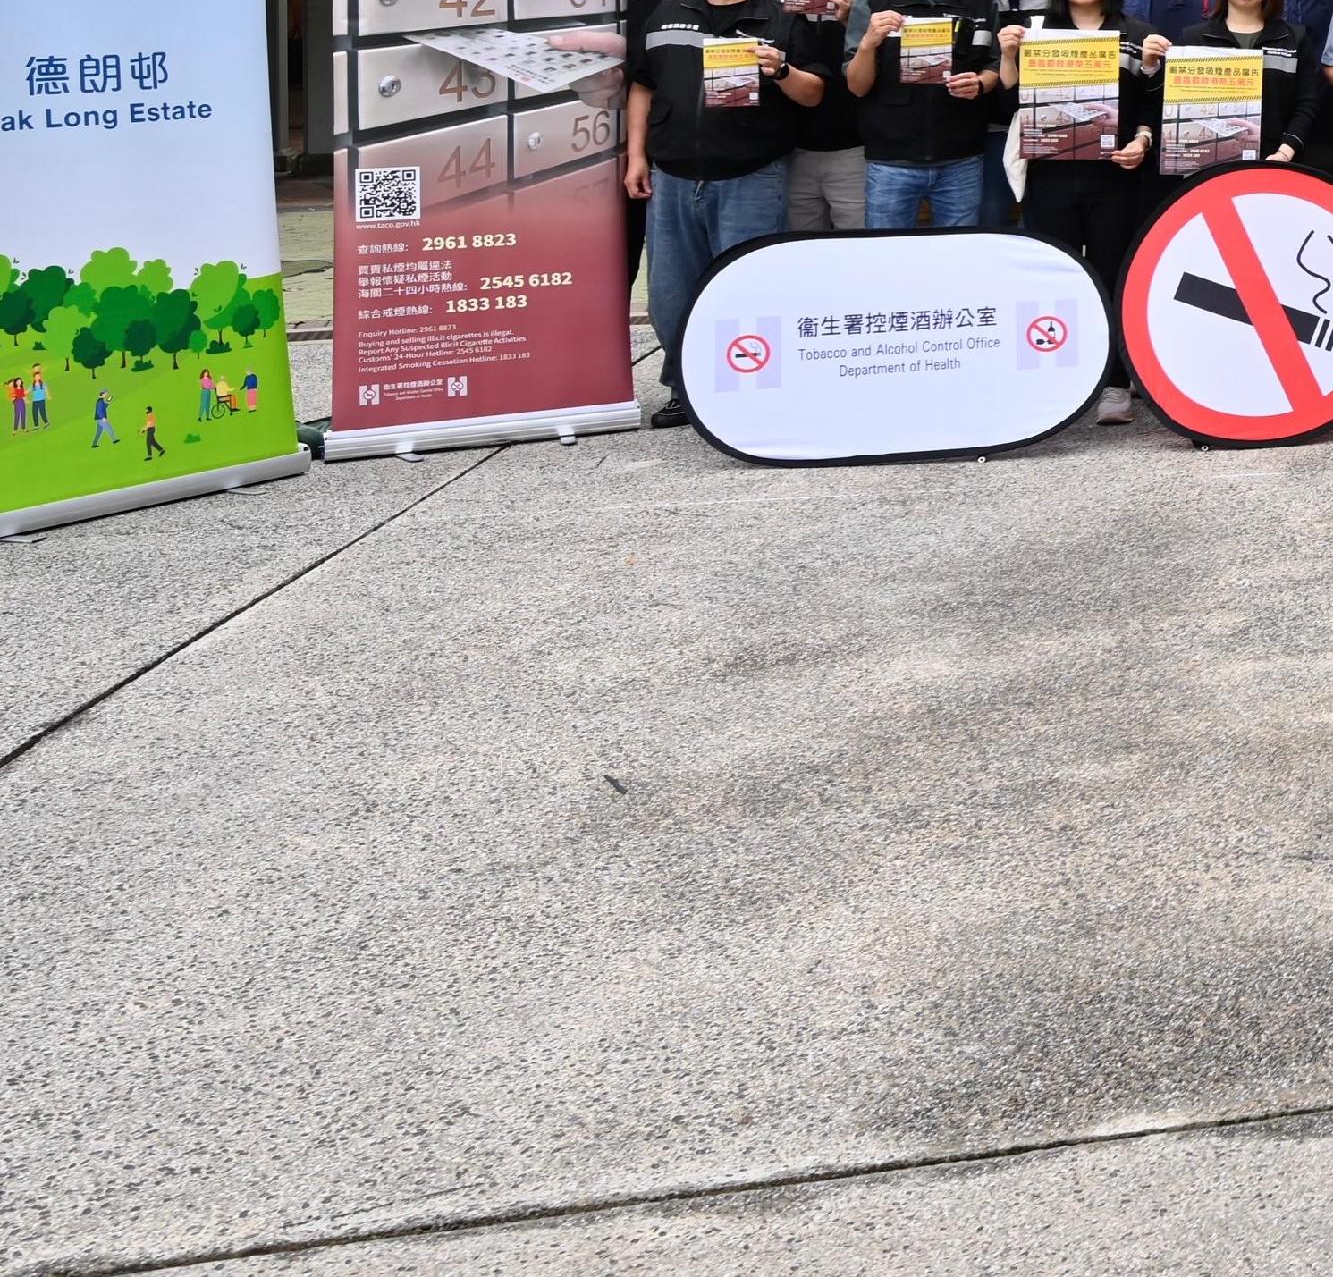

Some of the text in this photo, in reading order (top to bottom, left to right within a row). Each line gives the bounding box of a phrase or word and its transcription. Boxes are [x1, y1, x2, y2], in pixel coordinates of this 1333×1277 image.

[25, 51, 168, 96] 德朗邨
[1, 100, 212, 132] ak Long Estate
[437, 110, 611, 188] 44 56
[422, 236, 468, 252] 2961
[472, 233, 517, 248] 8823
[480, 275, 525, 290] 2545
[528, 272, 573, 288] 6182
[446, 297, 491, 313] 1833
[494, 294, 528, 310] 183
[797, 337, 1001, 361] Tobacco and Alcohol Control Office
[839, 357, 961, 379] Department of Health
